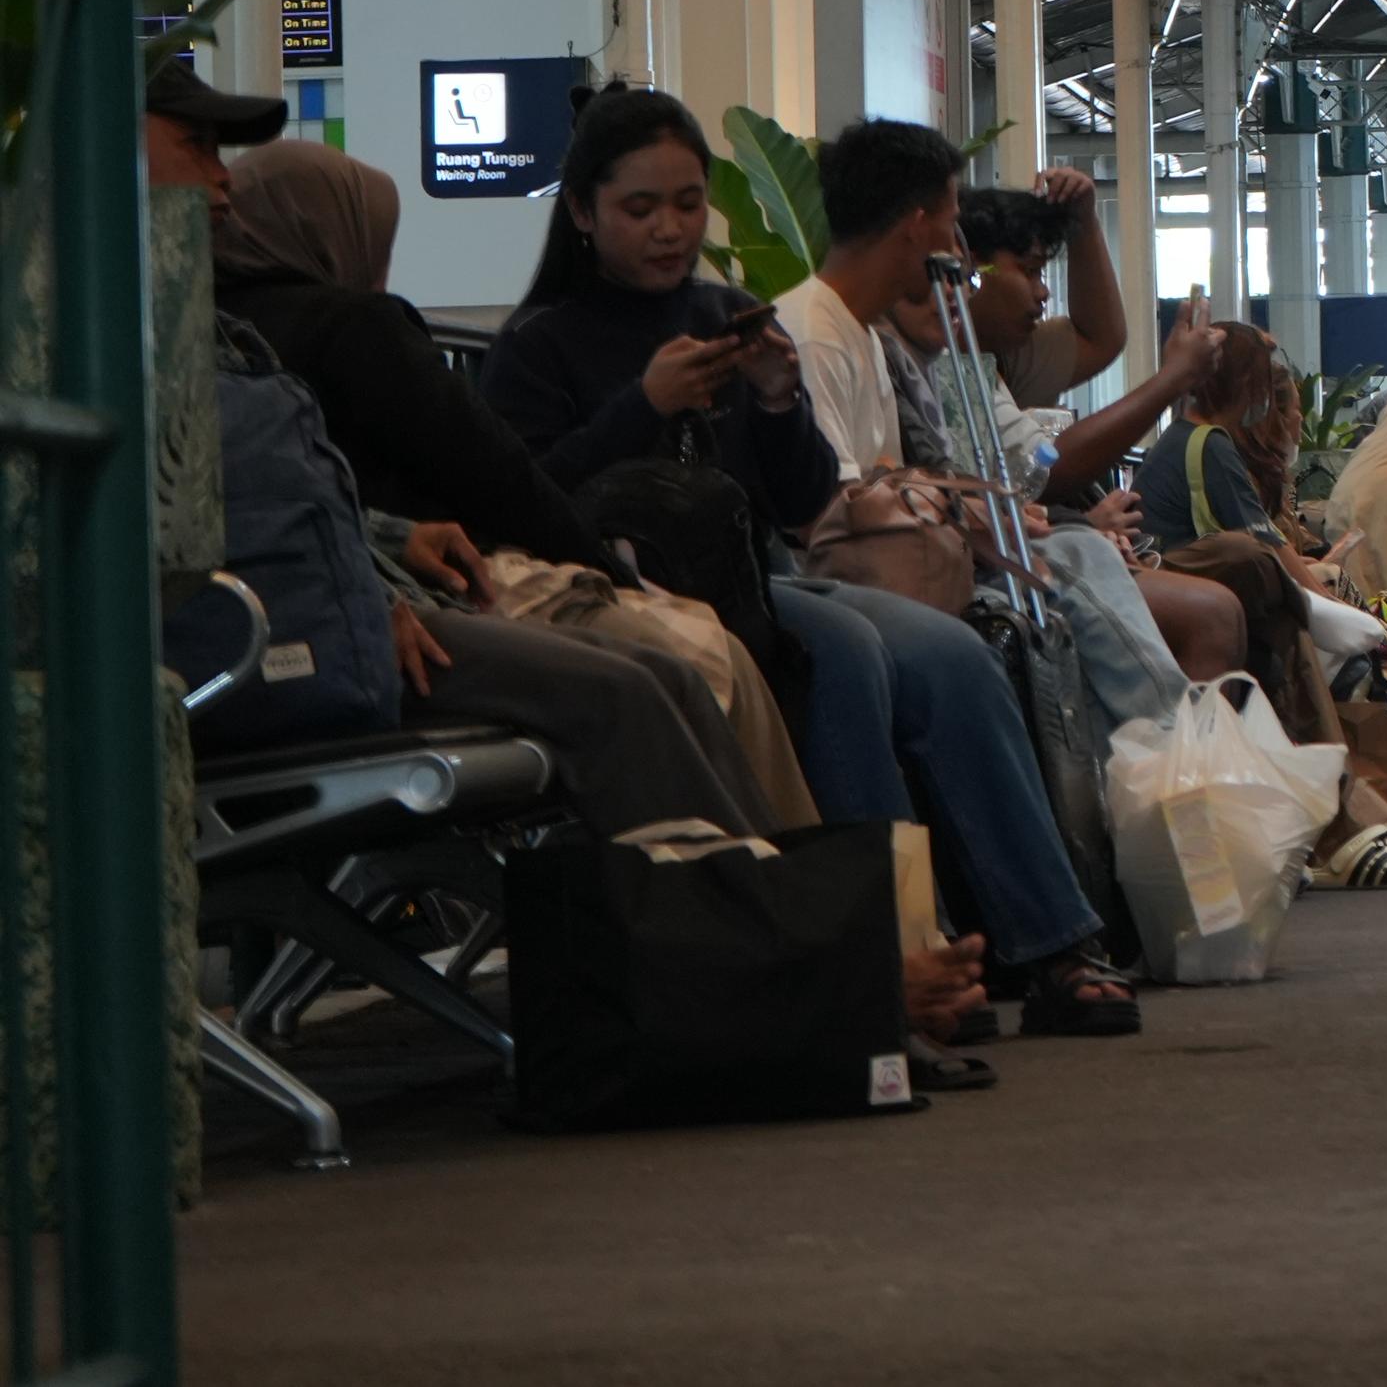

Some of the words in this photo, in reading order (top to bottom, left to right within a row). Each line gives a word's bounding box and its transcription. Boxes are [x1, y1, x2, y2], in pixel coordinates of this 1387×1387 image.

[283, 0, 298, 10] On
[284, 18, 299, 28] On
[302, 17, 328, 28] Time
[284, 36, 300, 47] On
[302, 35, 329, 47] Time
[436, 152, 480, 168] Ruang
[482, 151, 534, 167] Tunggu
[436, 169, 475, 182] Waiting
[477, 169, 506, 180] Room
